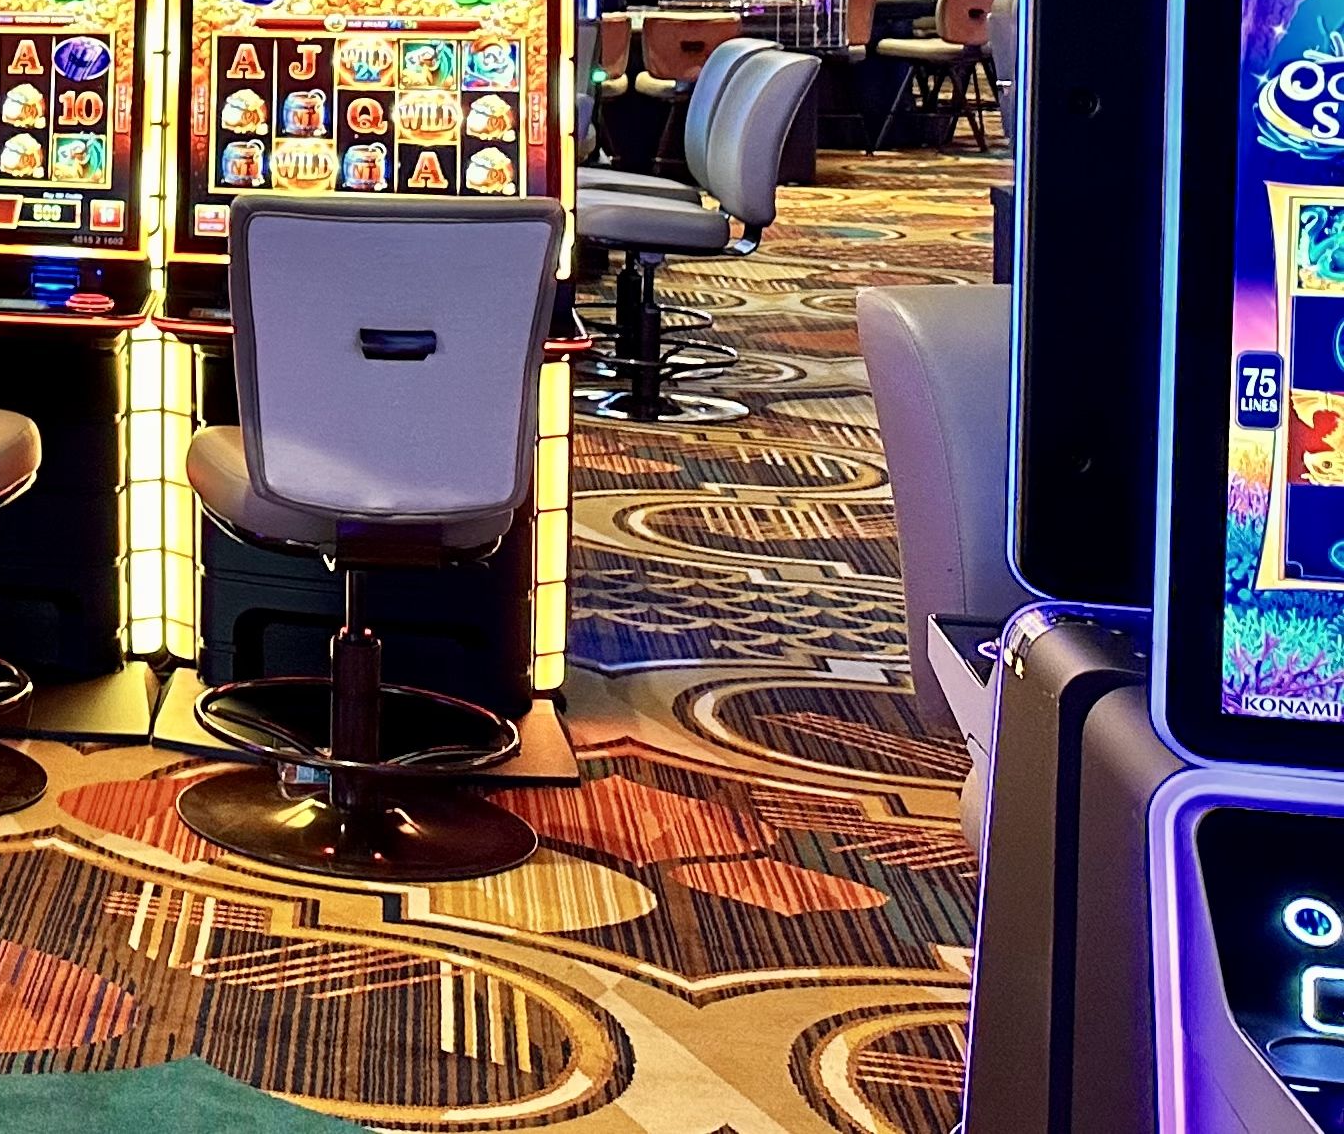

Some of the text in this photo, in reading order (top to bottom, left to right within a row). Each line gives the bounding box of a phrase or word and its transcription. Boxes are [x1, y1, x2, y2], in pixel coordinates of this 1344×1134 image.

[7, 39, 44, 75] A
[226, 43, 265, 79] A
[289, 44, 322, 80] J
[340, 49, 393, 70] WILD
[59, 90, 104, 126] 10
[346, 97, 388, 135] Q
[398, 104, 458, 132] WILD
[276, 152, 333, 181] WILD
[407, 151, 449, 188] A
[1242, 367, 1277, 397] 75
[1240, 397, 1278, 413] LINES
[1243, 696, 1340, 716] KONAMI
